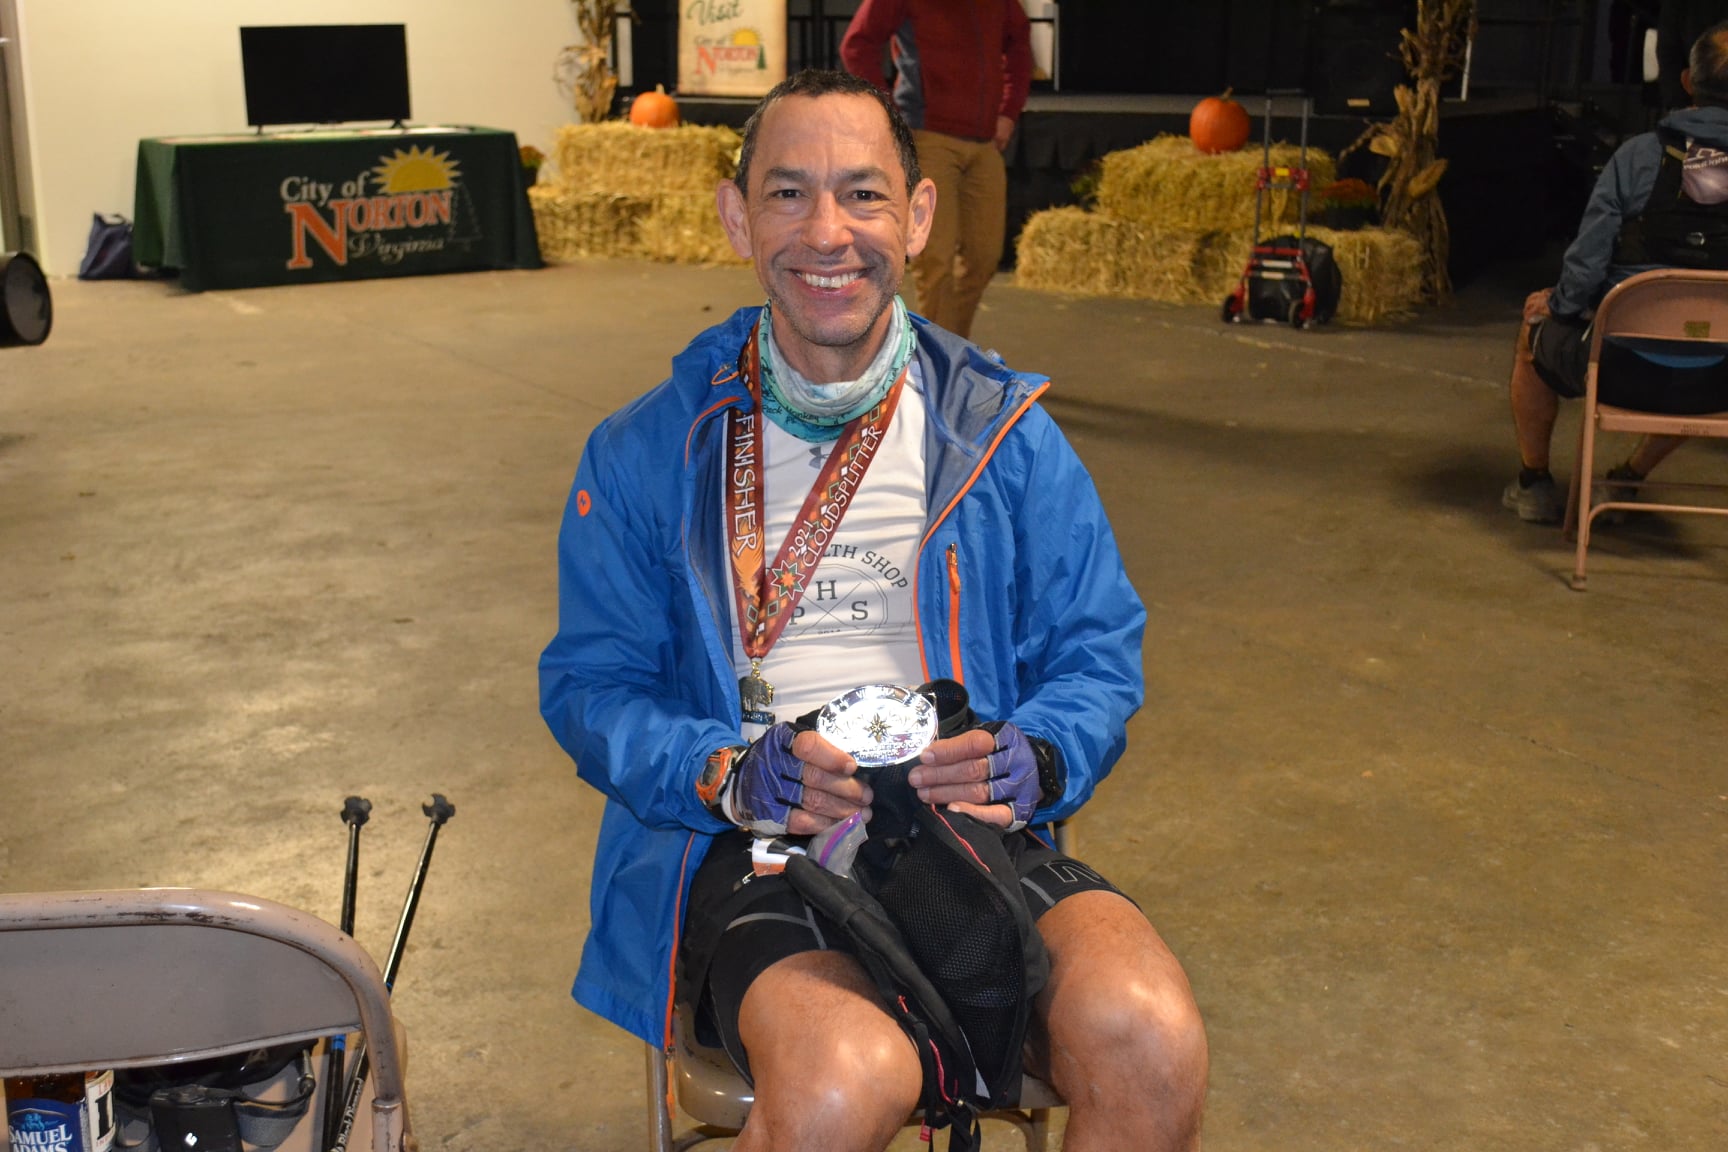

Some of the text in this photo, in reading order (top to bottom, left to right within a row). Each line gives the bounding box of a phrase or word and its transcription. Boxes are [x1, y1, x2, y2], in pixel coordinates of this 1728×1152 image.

[279, 171, 370, 206] City of
[284, 190, 454, 270] NORTON
[348, 232, 445, 265] Virginia
[733, 413, 757, 556] FINISHER
[802, 425, 882, 567] CLOUDSPLITTER
[788, 520, 814, 557] 2021
[861, 551, 908, 589] SHOP
[816, 580, 838, 601] H
[851, 600, 868, 621] S
[8, 1123, 73, 1145] SAMUEL
